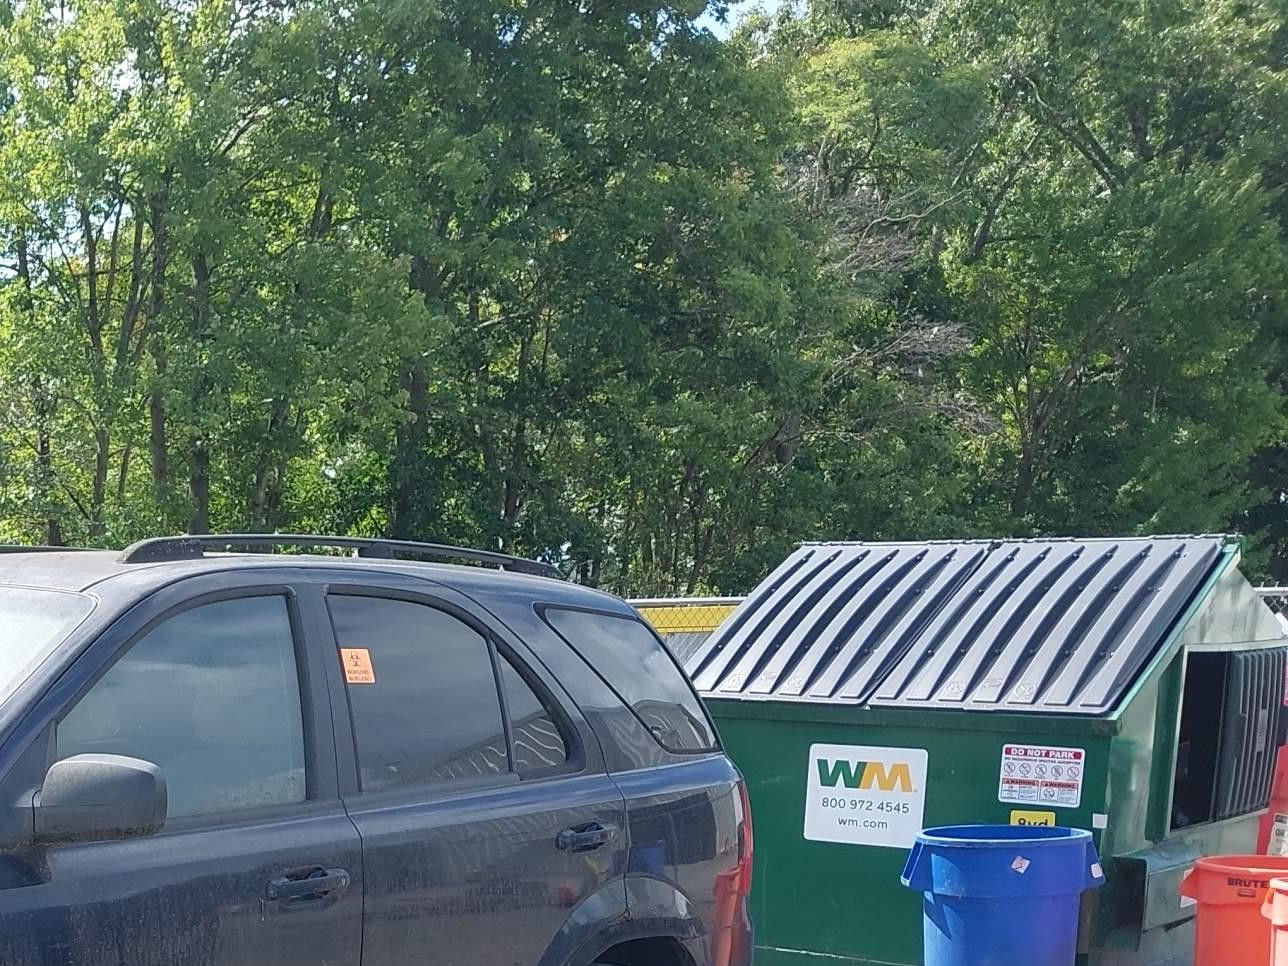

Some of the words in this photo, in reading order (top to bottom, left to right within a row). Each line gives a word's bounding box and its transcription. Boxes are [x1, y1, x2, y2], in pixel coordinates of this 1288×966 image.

[1027, 749, 1048, 757] NOT
[1049, 751, 1075, 759] PARK
[817, 758, 913, 793] WM
[822, 797, 846, 809] 800
[850, 799, 873, 811] 972
[877, 801, 910, 814] 4545
[838, 817, 888, 830] wm.com
[1227, 877, 1269, 889] BRUTE
